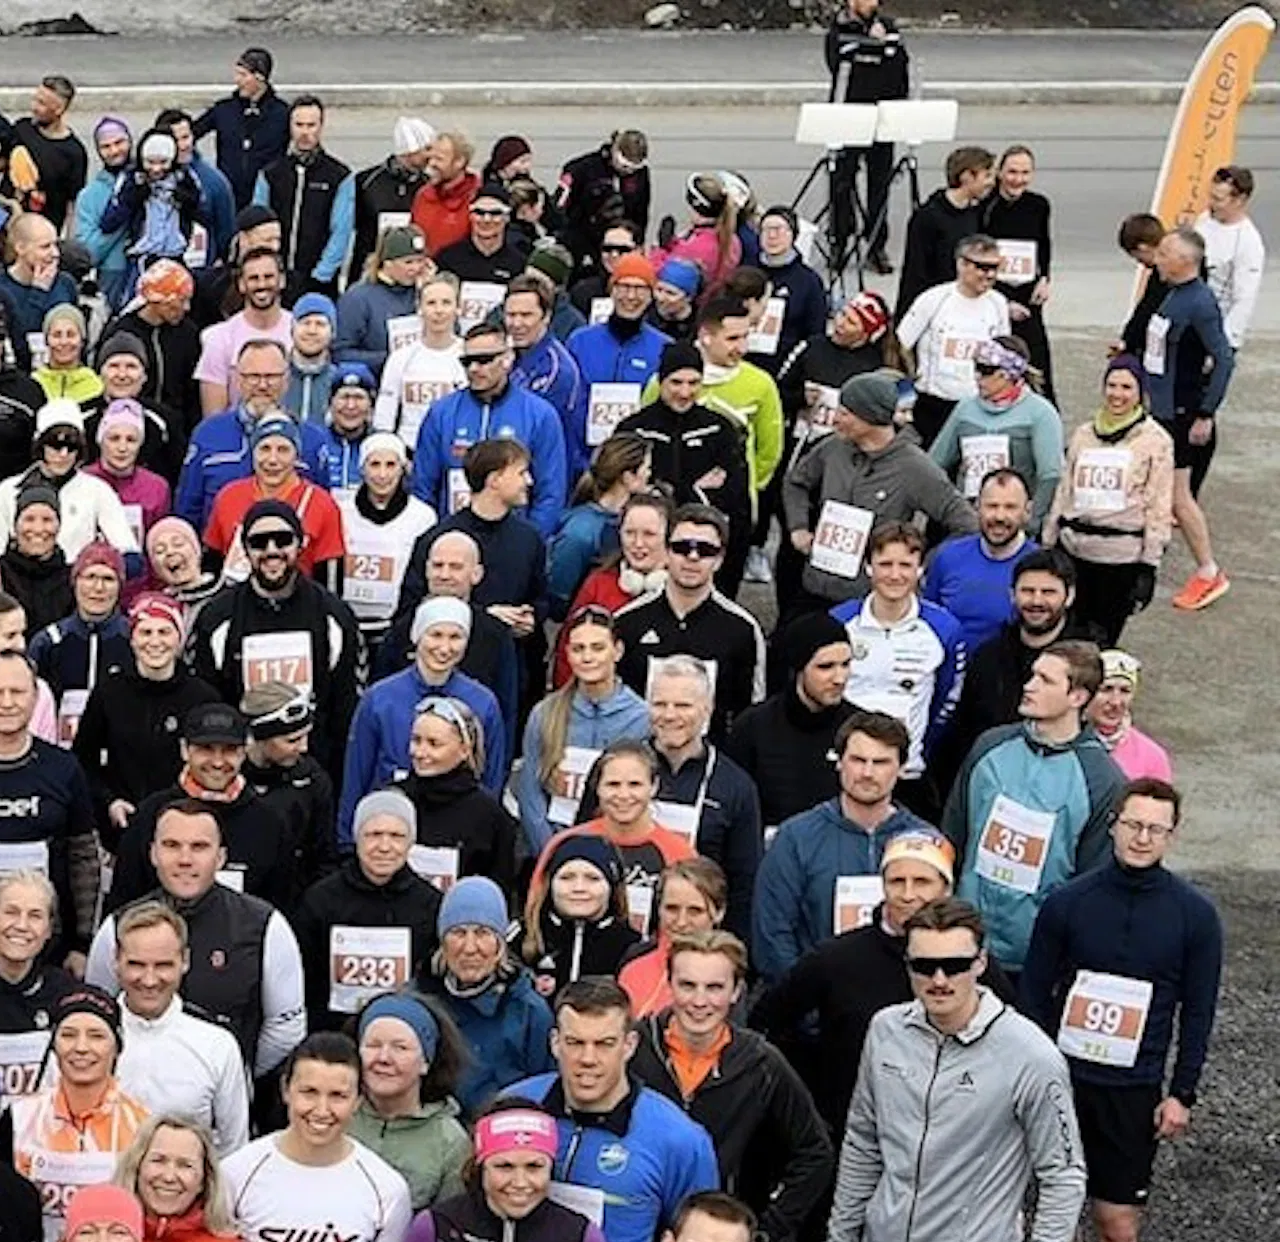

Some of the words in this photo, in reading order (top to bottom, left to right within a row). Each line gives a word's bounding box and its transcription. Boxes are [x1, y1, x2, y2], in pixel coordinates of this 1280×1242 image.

[354, 557, 380, 580] 25
[993, 828, 1028, 860] 35
[344, 956, 396, 986] 233
[1085, 999, 1122, 1034] 99
